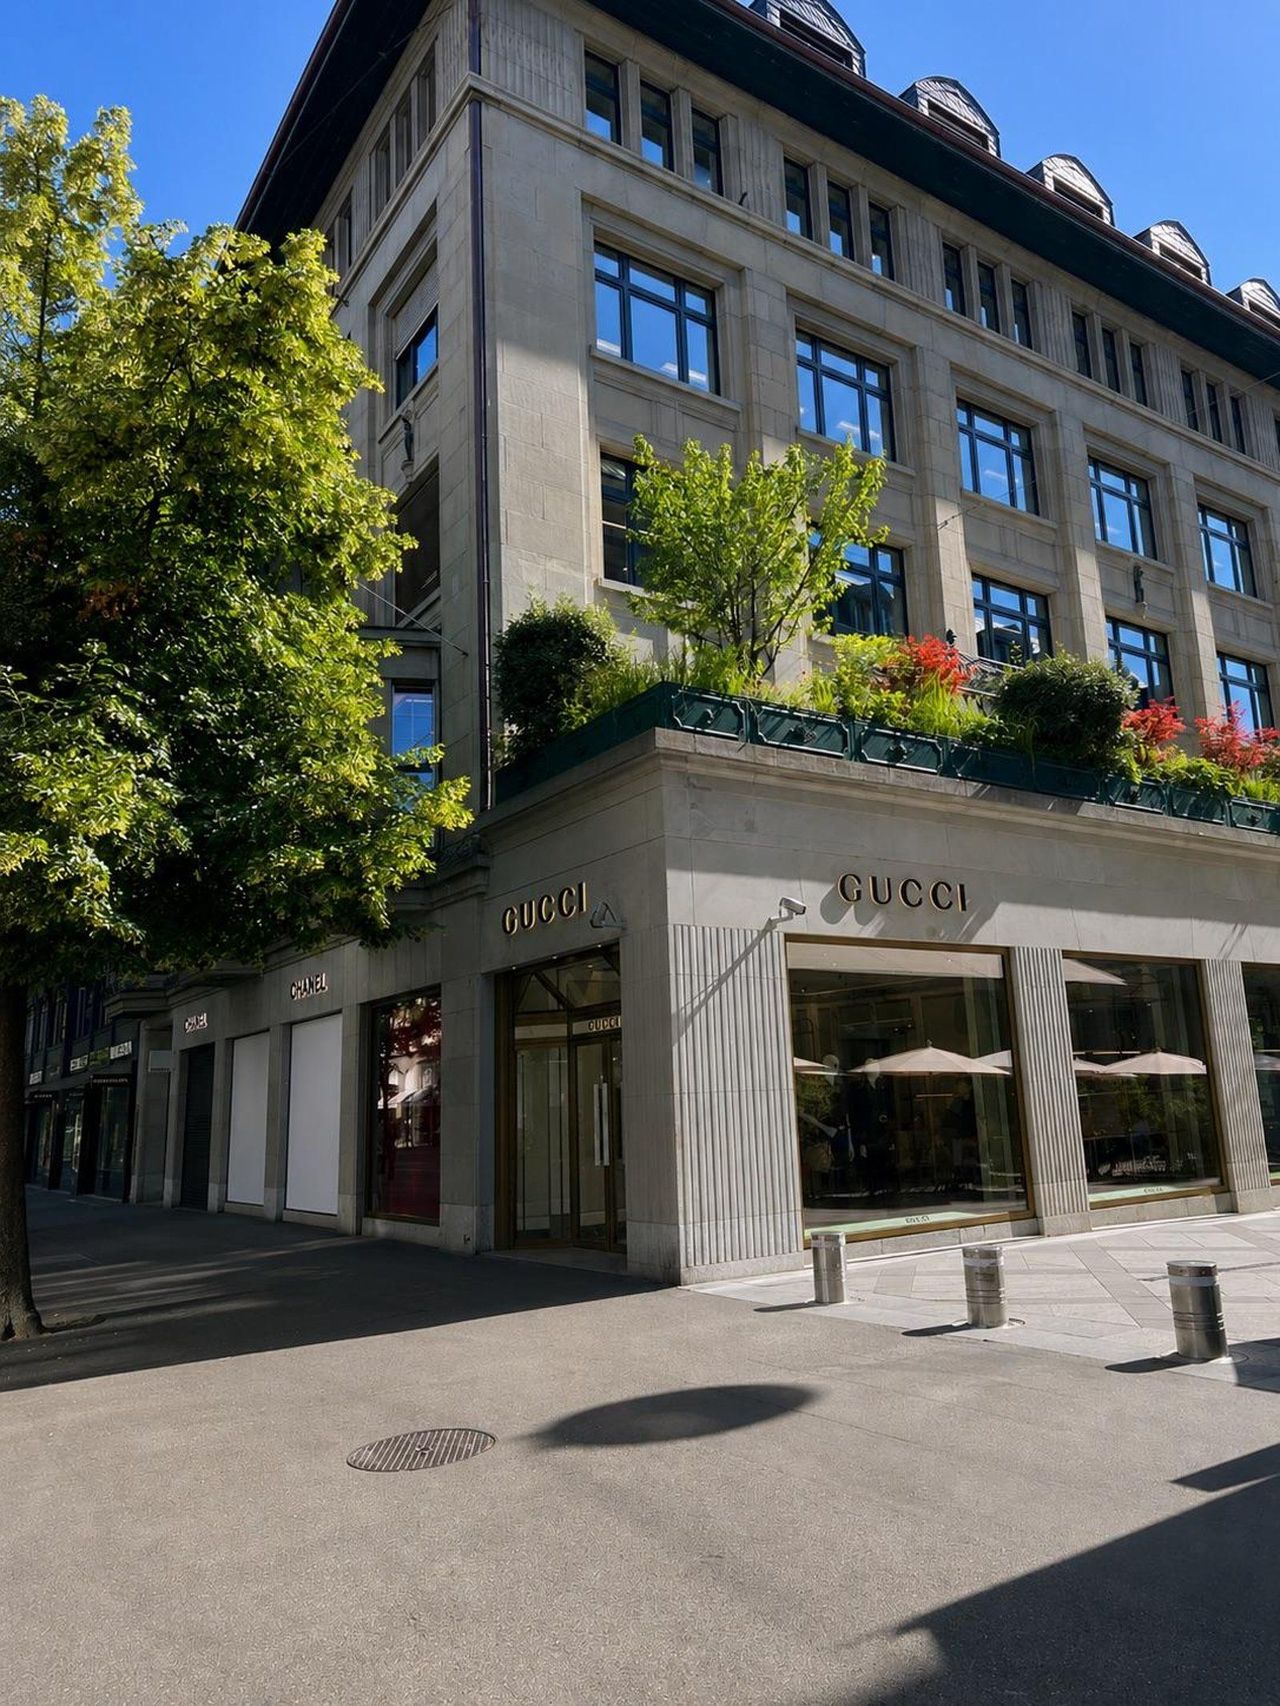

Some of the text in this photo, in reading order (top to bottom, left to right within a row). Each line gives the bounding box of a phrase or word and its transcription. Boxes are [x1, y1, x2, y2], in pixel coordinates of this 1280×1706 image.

[502, 881, 587, 935] GUCCI
[838, 873, 967, 912] GUCCI
[290, 973, 328, 1000] CHANEL
